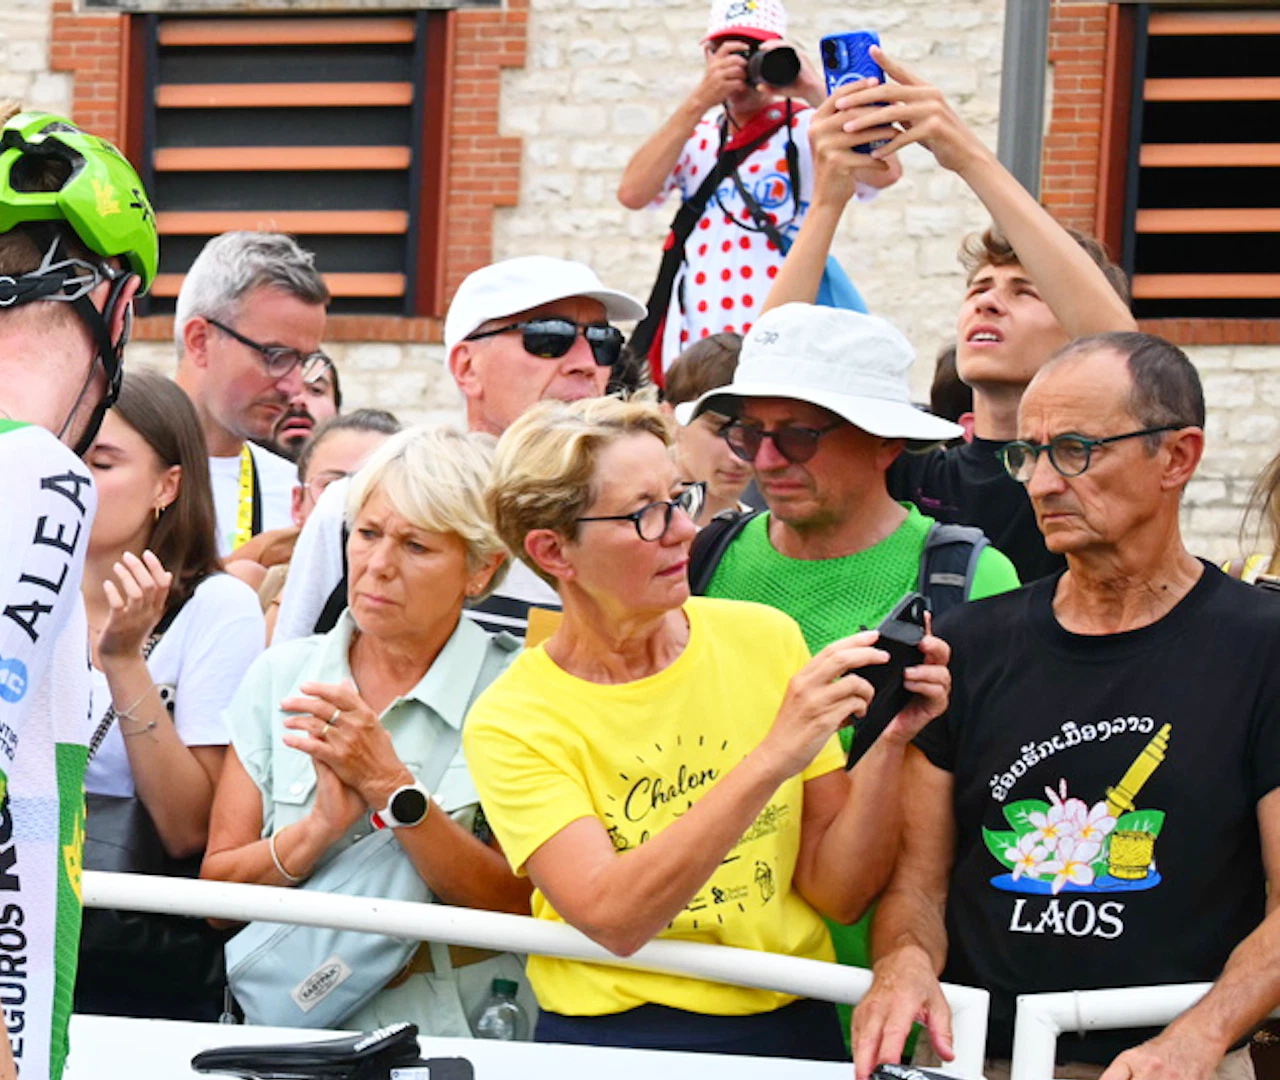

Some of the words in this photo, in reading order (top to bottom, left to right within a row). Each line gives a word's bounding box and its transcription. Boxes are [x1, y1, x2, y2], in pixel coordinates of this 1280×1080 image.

[2, 468, 92, 643] ALEA
[624, 764, 722, 822] Chalon
[1009, 899, 1124, 939] LAOS
